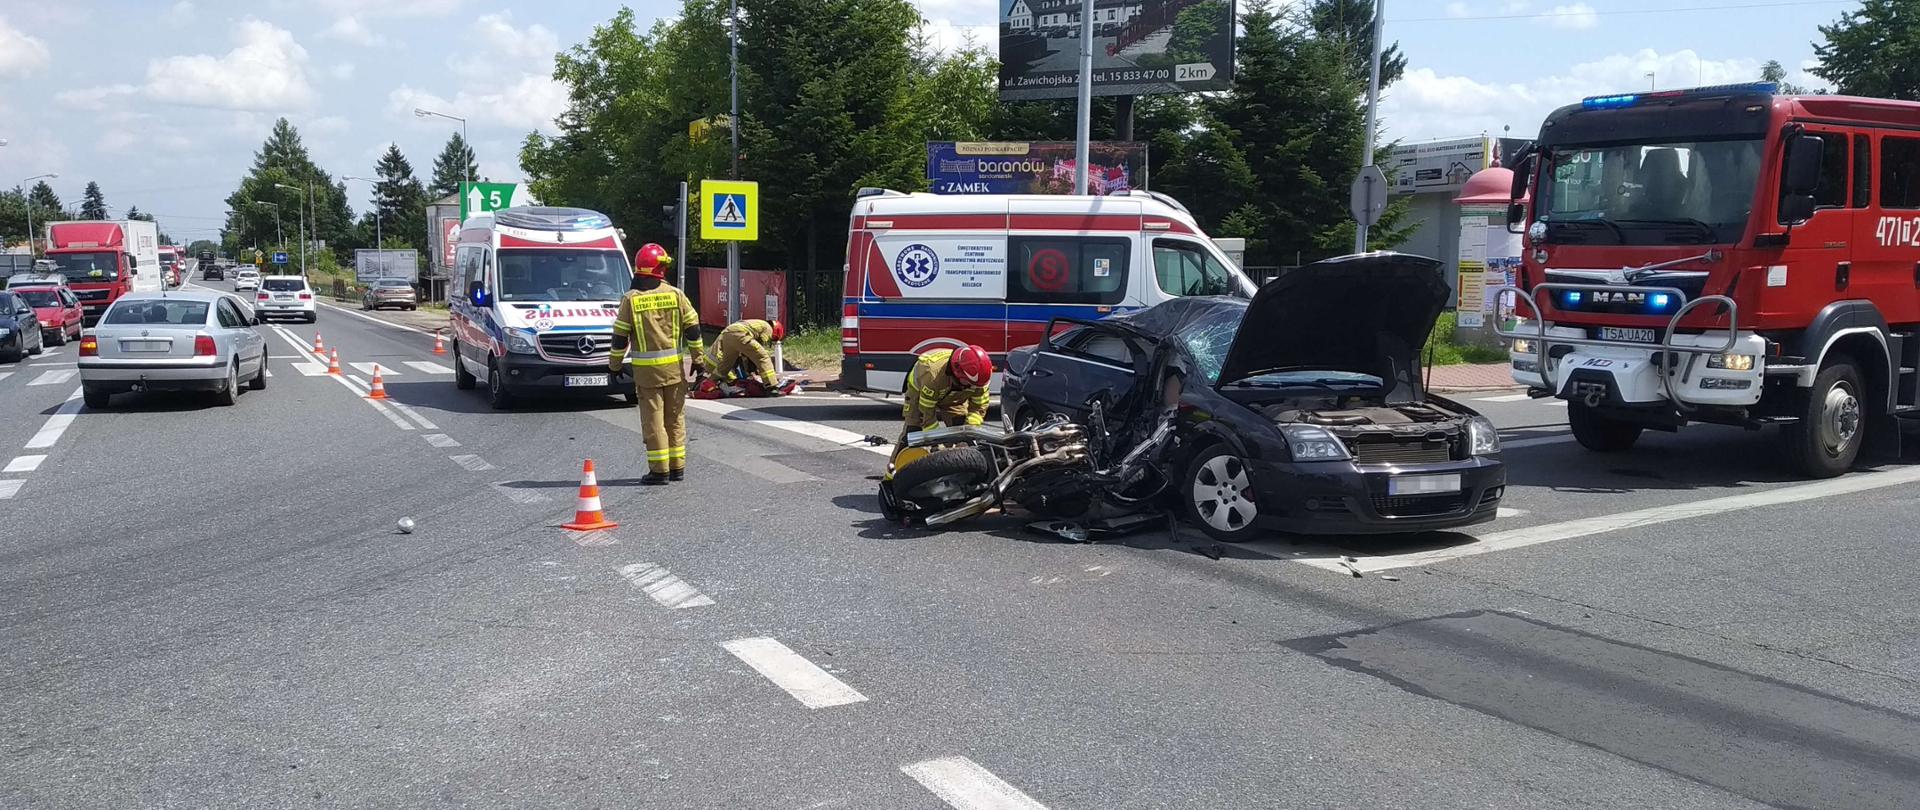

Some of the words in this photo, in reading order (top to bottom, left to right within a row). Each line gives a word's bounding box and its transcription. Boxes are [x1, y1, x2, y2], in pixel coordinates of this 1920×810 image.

[1004, 78, 1016, 87] ul.
[1017, 75, 1073, 88] Zawichojska
[1092, 71, 1108, 82] tel.
[1110, 72, 1121, 81] 15
[1122, 71, 1141, 81] 833
[1142, 70, 1155, 80] 47
[1156, 69, 1170, 79] 00
[1179, 67, 1187, 79] 2
[1188, 66, 1208, 78] km
[978, 158, 1044, 173] baranów
[947, 182, 990, 192] ZAMEK
[489, 190, 502, 208] 5
[1040, 257, 1057, 281] S
[1593, 291, 1645, 304] MAN
[1604, 328, 1625, 340] TSA
[1628, 329, 1654, 342] UA20
